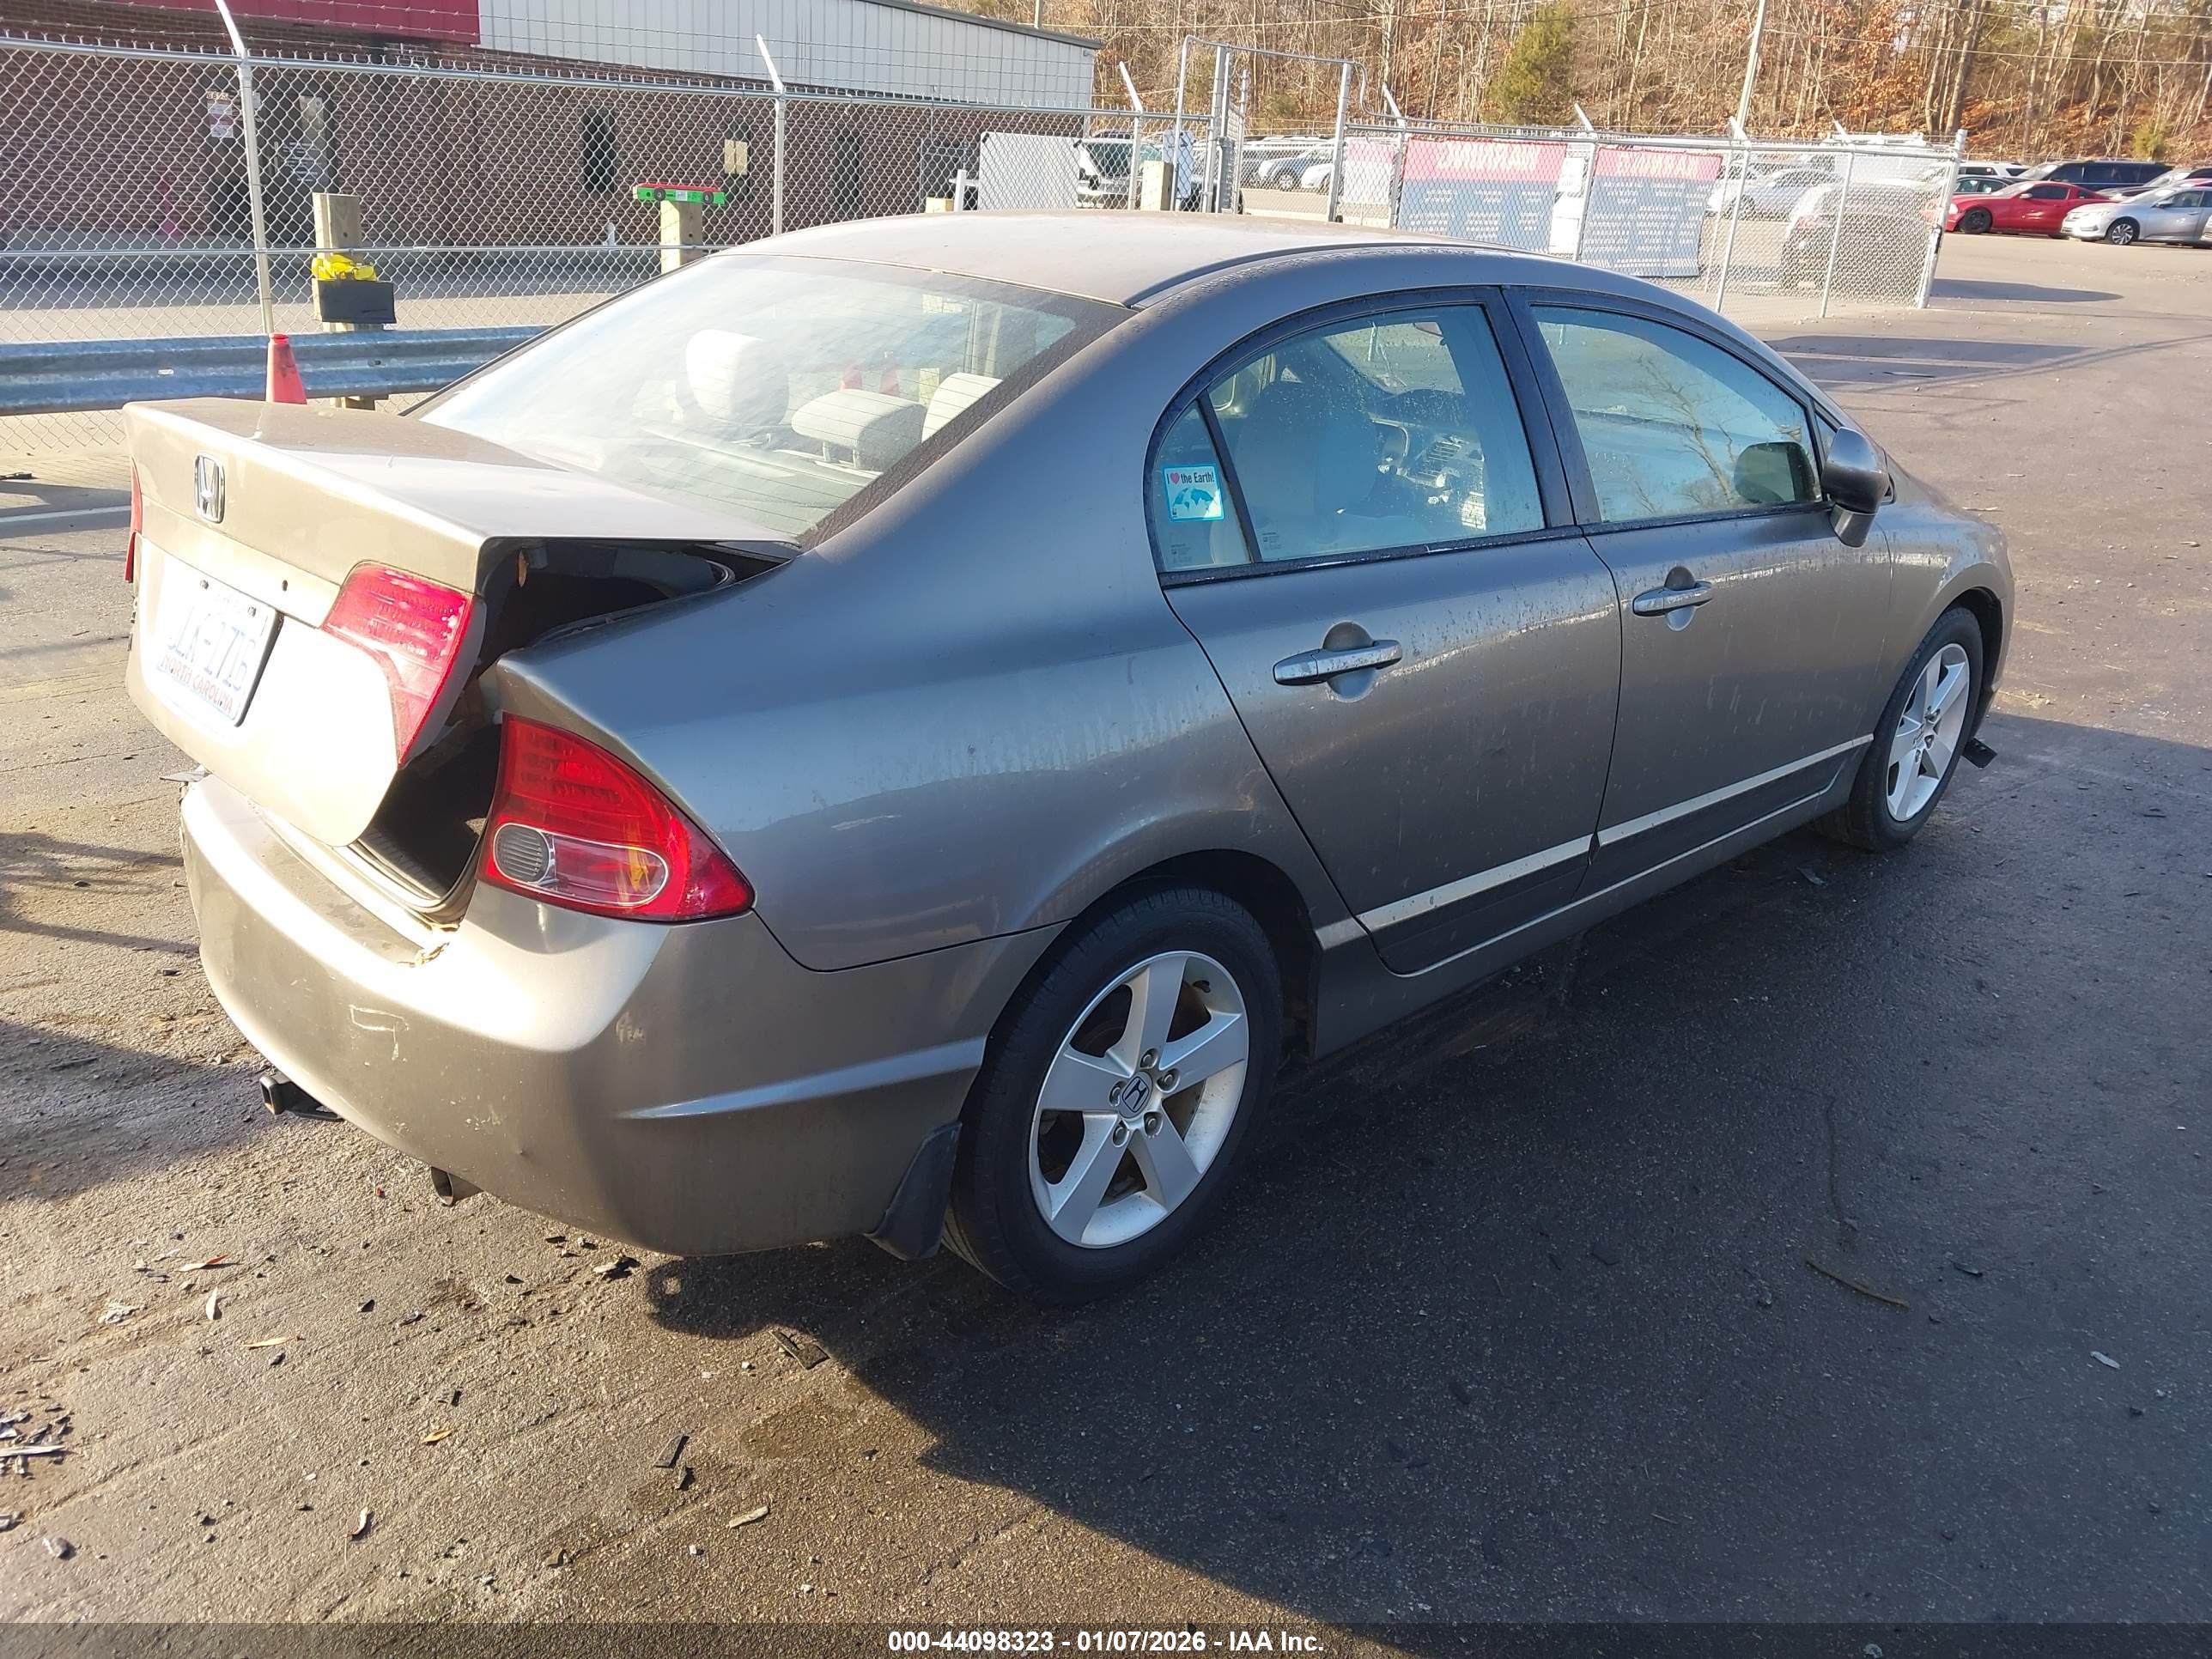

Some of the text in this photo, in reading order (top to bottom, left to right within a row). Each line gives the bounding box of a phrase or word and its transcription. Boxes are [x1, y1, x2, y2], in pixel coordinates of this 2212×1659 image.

[1181, 473, 1193, 484] the
[1194, 471, 1215, 483] Earth!
[160, 654, 234, 714] NORTH CAROLINA
